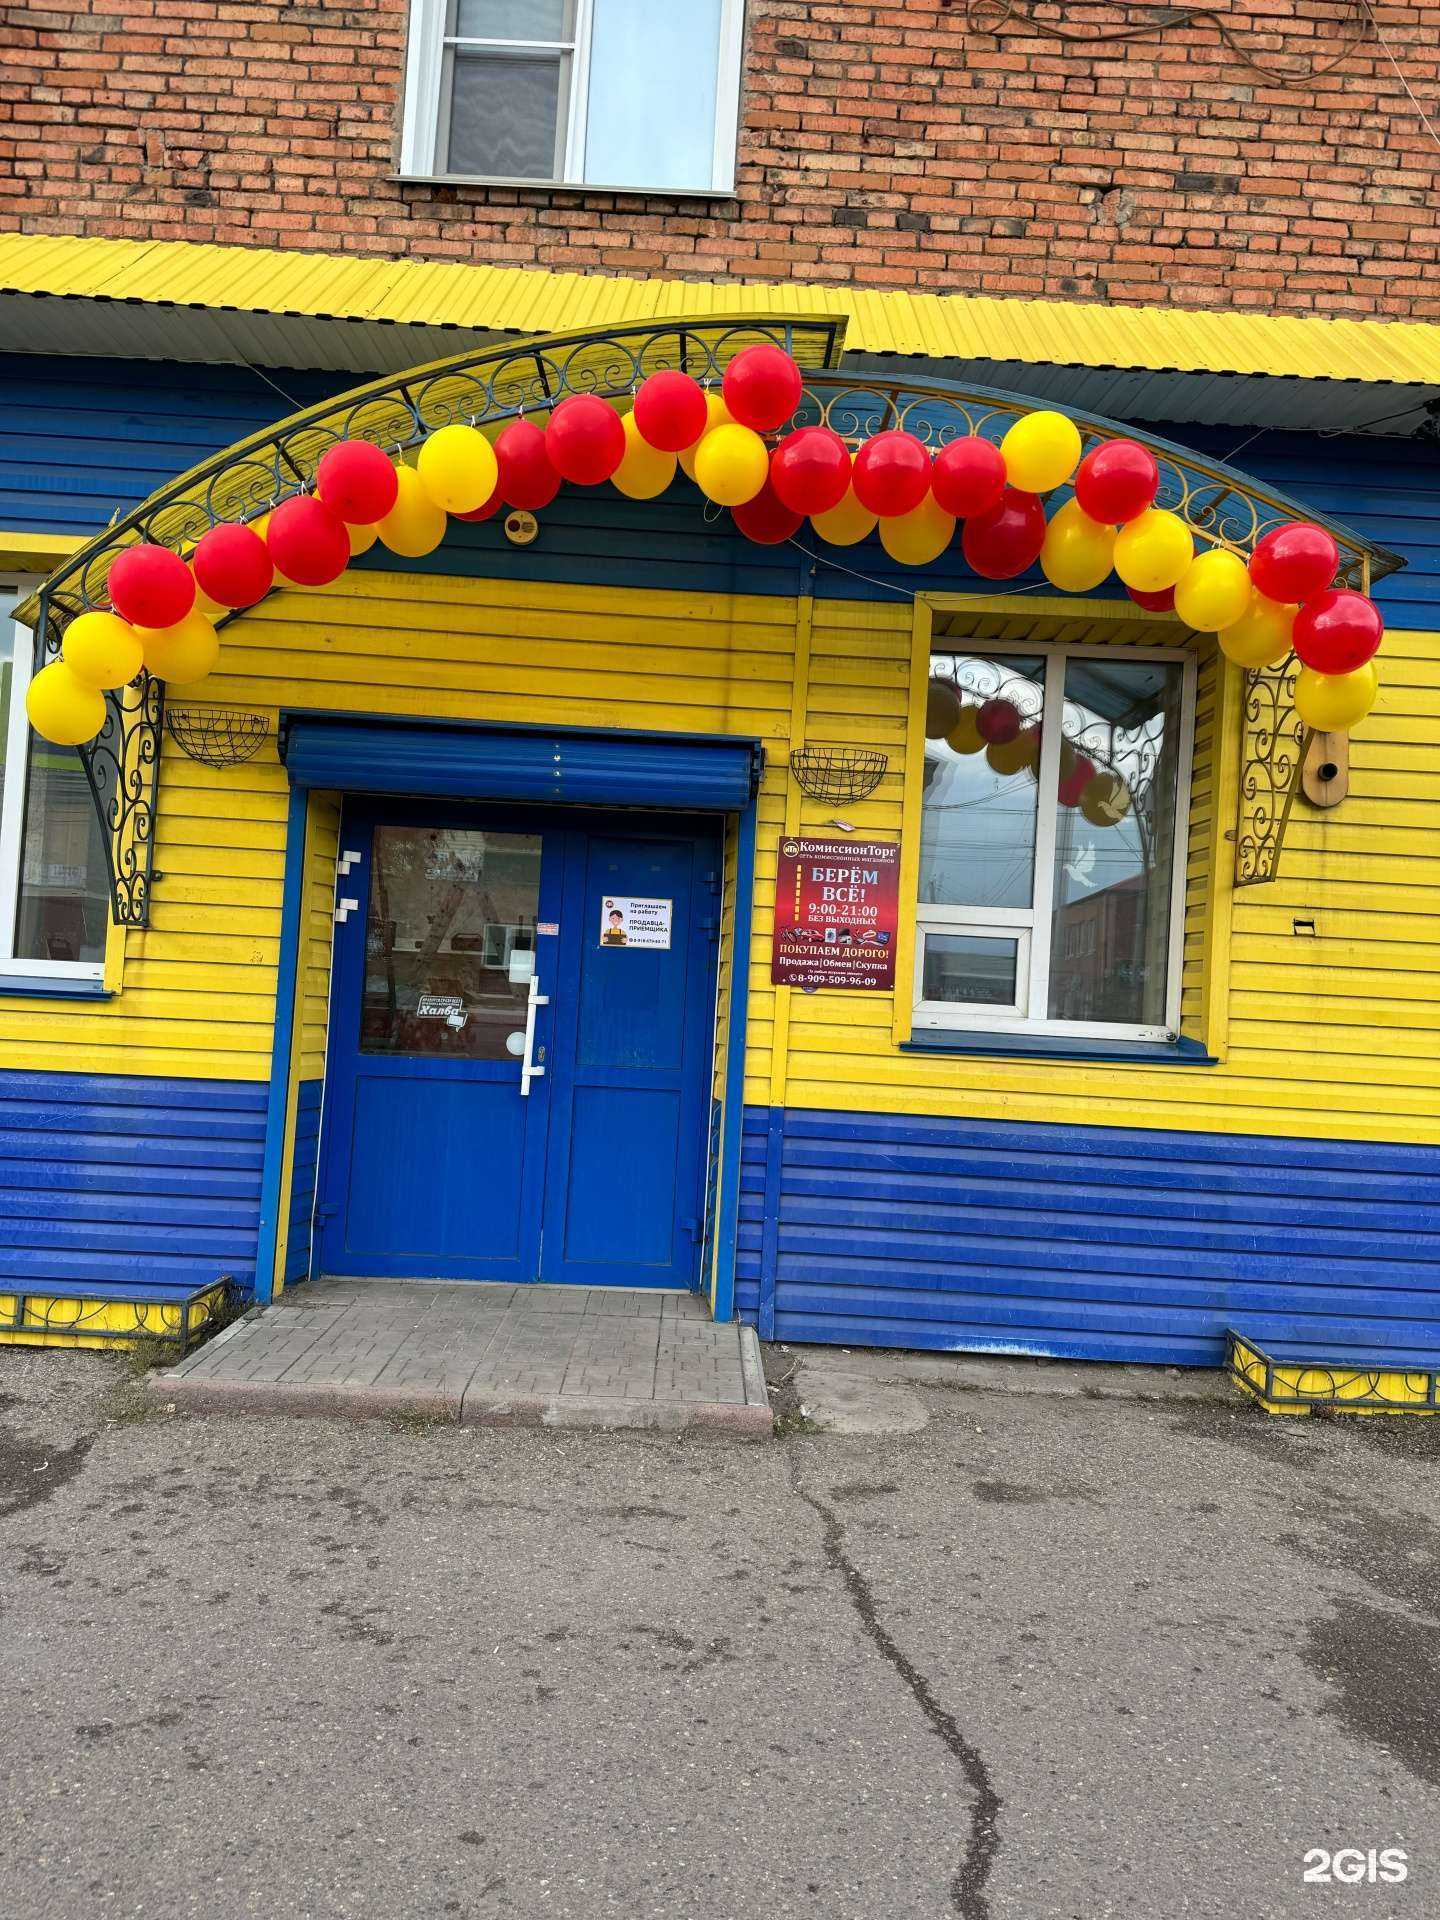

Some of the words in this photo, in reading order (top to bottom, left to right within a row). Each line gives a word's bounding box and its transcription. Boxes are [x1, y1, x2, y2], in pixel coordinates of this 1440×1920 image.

[799, 841, 896, 859] КомиссионТорг
[811, 866, 879, 885] БЕРЁМ
[822, 885, 866, 903] ВСЁ!
[808, 902, 878, 917] 9:00-21:00
[808, 914, 824, 922] БЕЗ
[825, 916, 877, 926] ВЫХОДНЫХ
[779, 944, 840, 956] ПОКУПАЕМ
[841, 947, 889, 959] ДОРОГО!
[797, 974, 877, 986] 8-909-509-96-09
